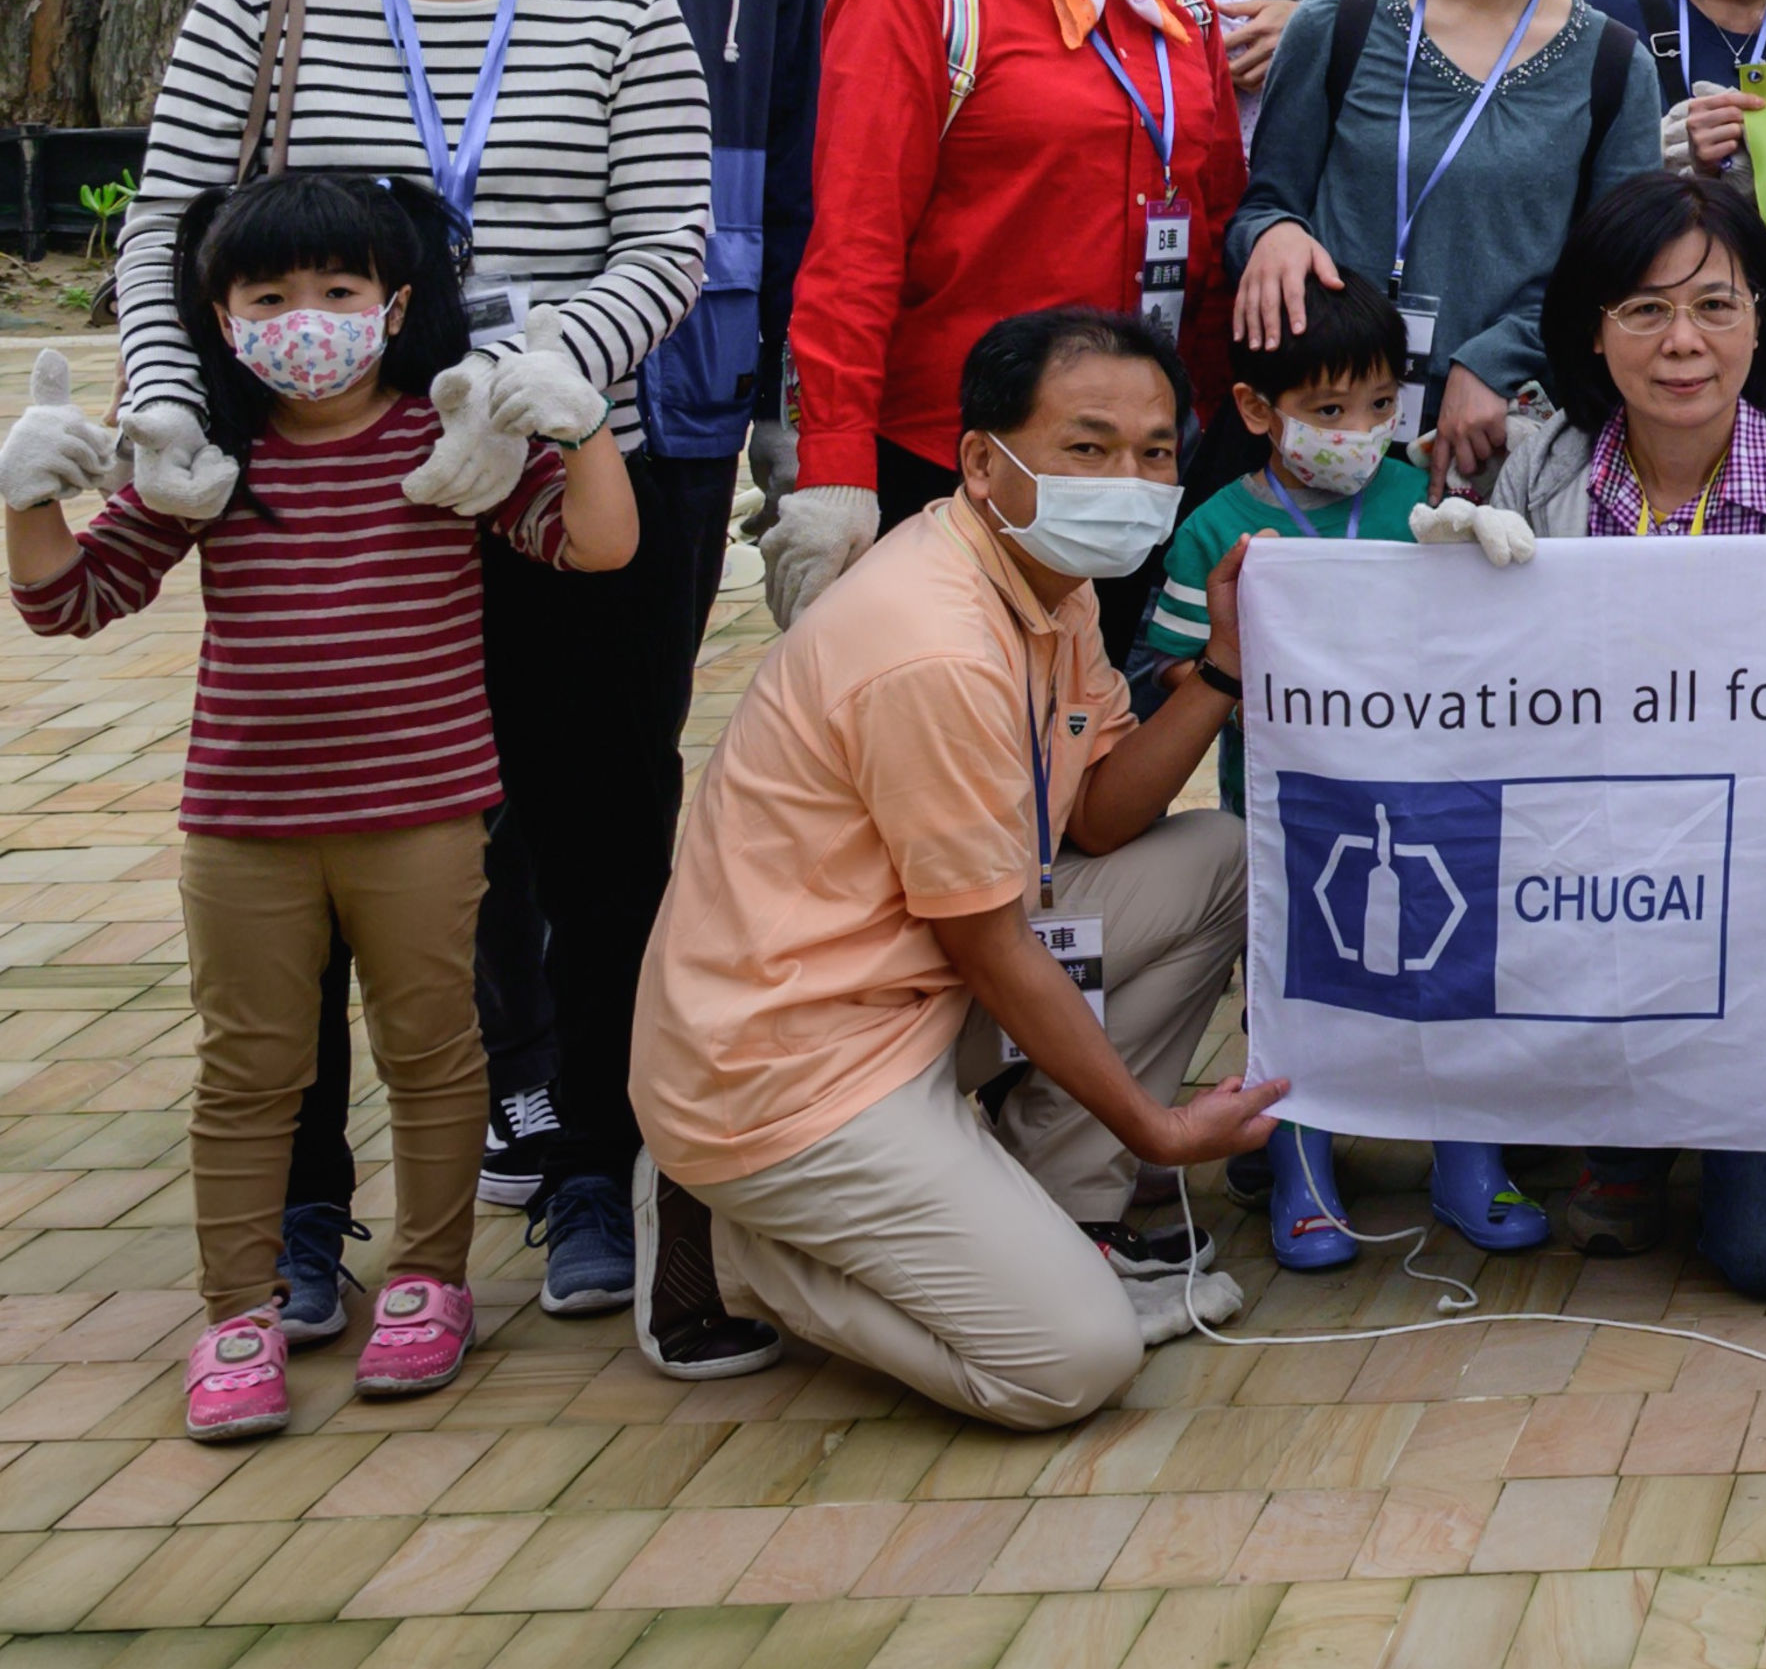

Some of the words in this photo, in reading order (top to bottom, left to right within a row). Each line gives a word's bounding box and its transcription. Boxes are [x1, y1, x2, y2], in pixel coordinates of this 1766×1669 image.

[1159, 228, 1178, 250] B車
[1265, 673, 1601, 730] Innovation
[1633, 670, 1696, 723] all
[1514, 874, 1705, 924] CHUGAI
